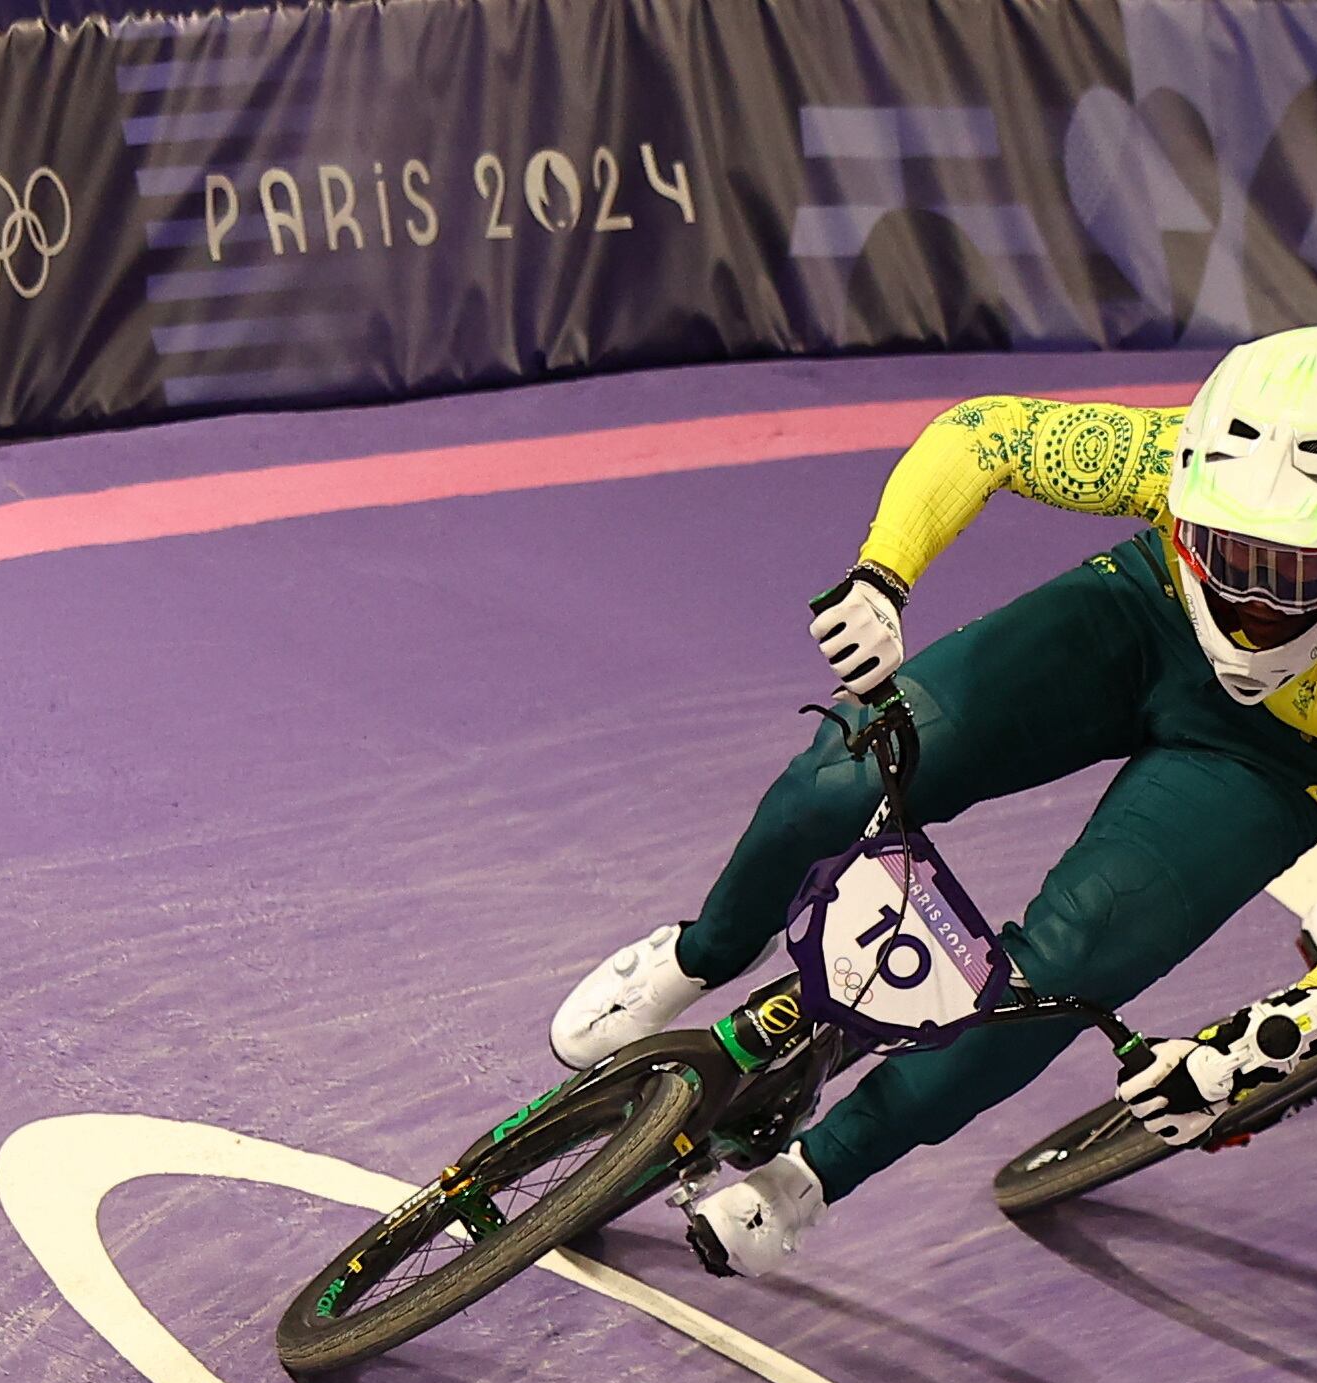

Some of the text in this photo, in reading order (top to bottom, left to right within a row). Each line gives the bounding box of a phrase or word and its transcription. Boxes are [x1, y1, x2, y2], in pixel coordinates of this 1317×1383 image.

[474, 142, 696, 240] 2024
[855, 904, 932, 990] 10
[938, 922, 973, 967] 2024
